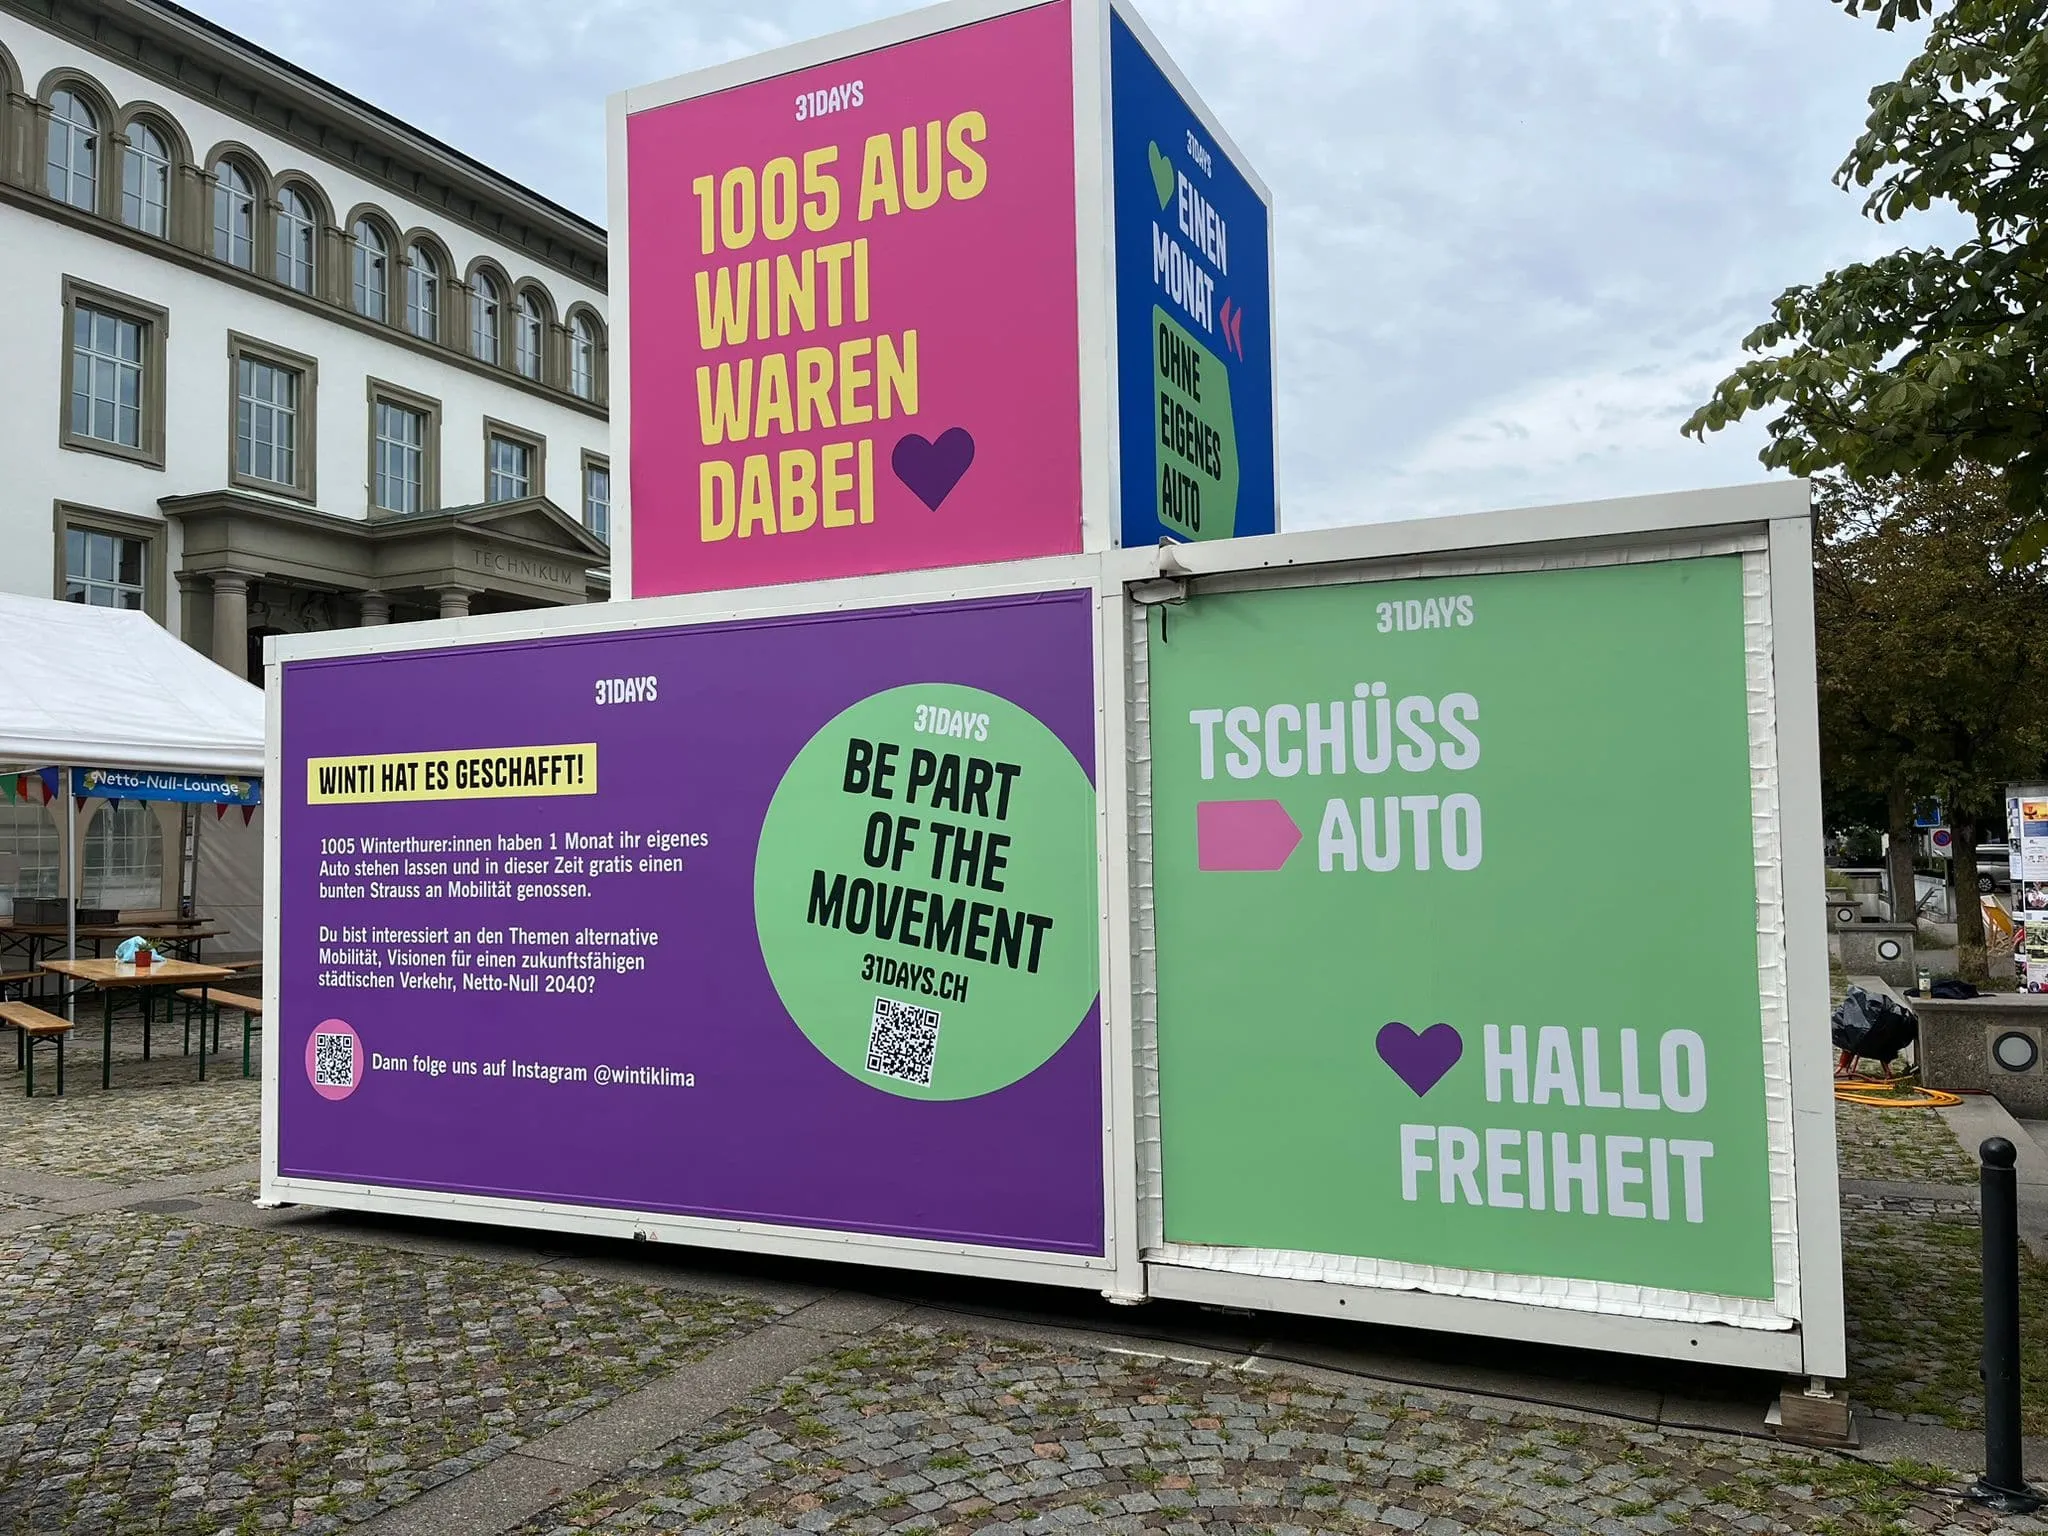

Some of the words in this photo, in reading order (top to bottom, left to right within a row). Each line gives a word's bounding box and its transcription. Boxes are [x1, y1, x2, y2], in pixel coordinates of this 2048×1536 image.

[795, 80, 864, 122] 31DAYS
[693, 144, 841, 255] 1005
[858, 110, 988, 222] AUS
[1186, 129, 1212, 179] 31DAYS
[1177, 170, 1227, 276] EINEN
[695, 238, 870, 350] WINTI
[1152, 220, 1214, 334] MONAT
[696, 329, 918, 445] WAREN
[1160, 322, 1201, 403] OHNE
[1161, 396, 1221, 481] EIGENES
[700, 439, 874, 543] DABEI
[1162, 462, 1201, 533] AUTO
[472, 549, 573, 586] TECHNIKUM
[1376, 595, 1474, 633] 31DAYS
[595, 676, 658, 705] 31DAYS
[914, 704, 990, 742] 31DAYS
[1189, 681, 1480, 780] TSCHÜSS
[90, 771, 239, 794] Netto-Null-Lounge
[319, 765, 375, 795] WINTI
[381, 762, 419, 793] HAT
[425, 760, 449, 791] ES
[456, 754, 584, 789] GESCHAFFT!
[843, 737, 900, 800] BE
[905, 748, 1022, 821] PART
[321, 837, 355, 855] 1005
[360, 835, 492, 854] Winterthurer:innen
[497, 834, 542, 851] haben
[549, 833, 558, 850] 1
[565, 832, 614, 850] Monat
[620, 831, 641, 849] ihr
[646, 831, 709, 851] eigenes
[863, 811, 920, 872] OF
[930, 822, 1012, 893] THE
[1318, 793, 1483, 872] AUTO
[319, 859, 350, 877] Auto
[354, 860, 399, 876] stehen
[404, 858, 448, 876] lassen
[453, 858, 480, 875] und
[485, 858, 499, 874] in
[504, 857, 549, 874] dieser
[554, 856, 584, 873] Zeit
[590, 856, 633, 876] gratis
[639, 856, 683, 872] einen
[319, 881, 365, 899] bunten
[370, 881, 420, 899] Strauss
[425, 884, 443, 898] an
[448, 880, 512, 898] Mobilität
[517, 883, 591, 901] genossen.
[319, 927, 338, 943] Du
[343, 927, 367, 943] bist
[372, 928, 449, 944] interessiert
[454, 931, 471, 944] an
[477, 928, 503, 944] den
[508, 928, 569, 945] Themen
[575, 928, 658, 945] alternative
[806, 869, 1054, 974] MOVEMENT
[318, 970, 395, 988] städtischen
[399, 972, 456, 992] Verkehr,
[463, 974, 539, 992] Netto-Null
[545, 976, 595, 994] 2040?
[319, 949, 382, 967] Mobilität,
[387, 951, 446, 967] Visionen
[451, 950, 471, 967] für
[476, 951, 517, 968] einen
[522, 951, 645, 973] zukunftsfähigen
[861, 954, 969, 1003] 31DAYS.CH
[372, 1053, 408, 1071] Dann
[412, 1055, 447, 1075] folge
[452, 1060, 477, 1074] uns
[483, 1059, 506, 1076] auf
[512, 1060, 587, 1083] Instagram
[593, 1065, 695, 1087] @wintiklima
[1483, 1024, 1707, 1113] HALLO
[1400, 1124, 1714, 1223] FREIHEIT
